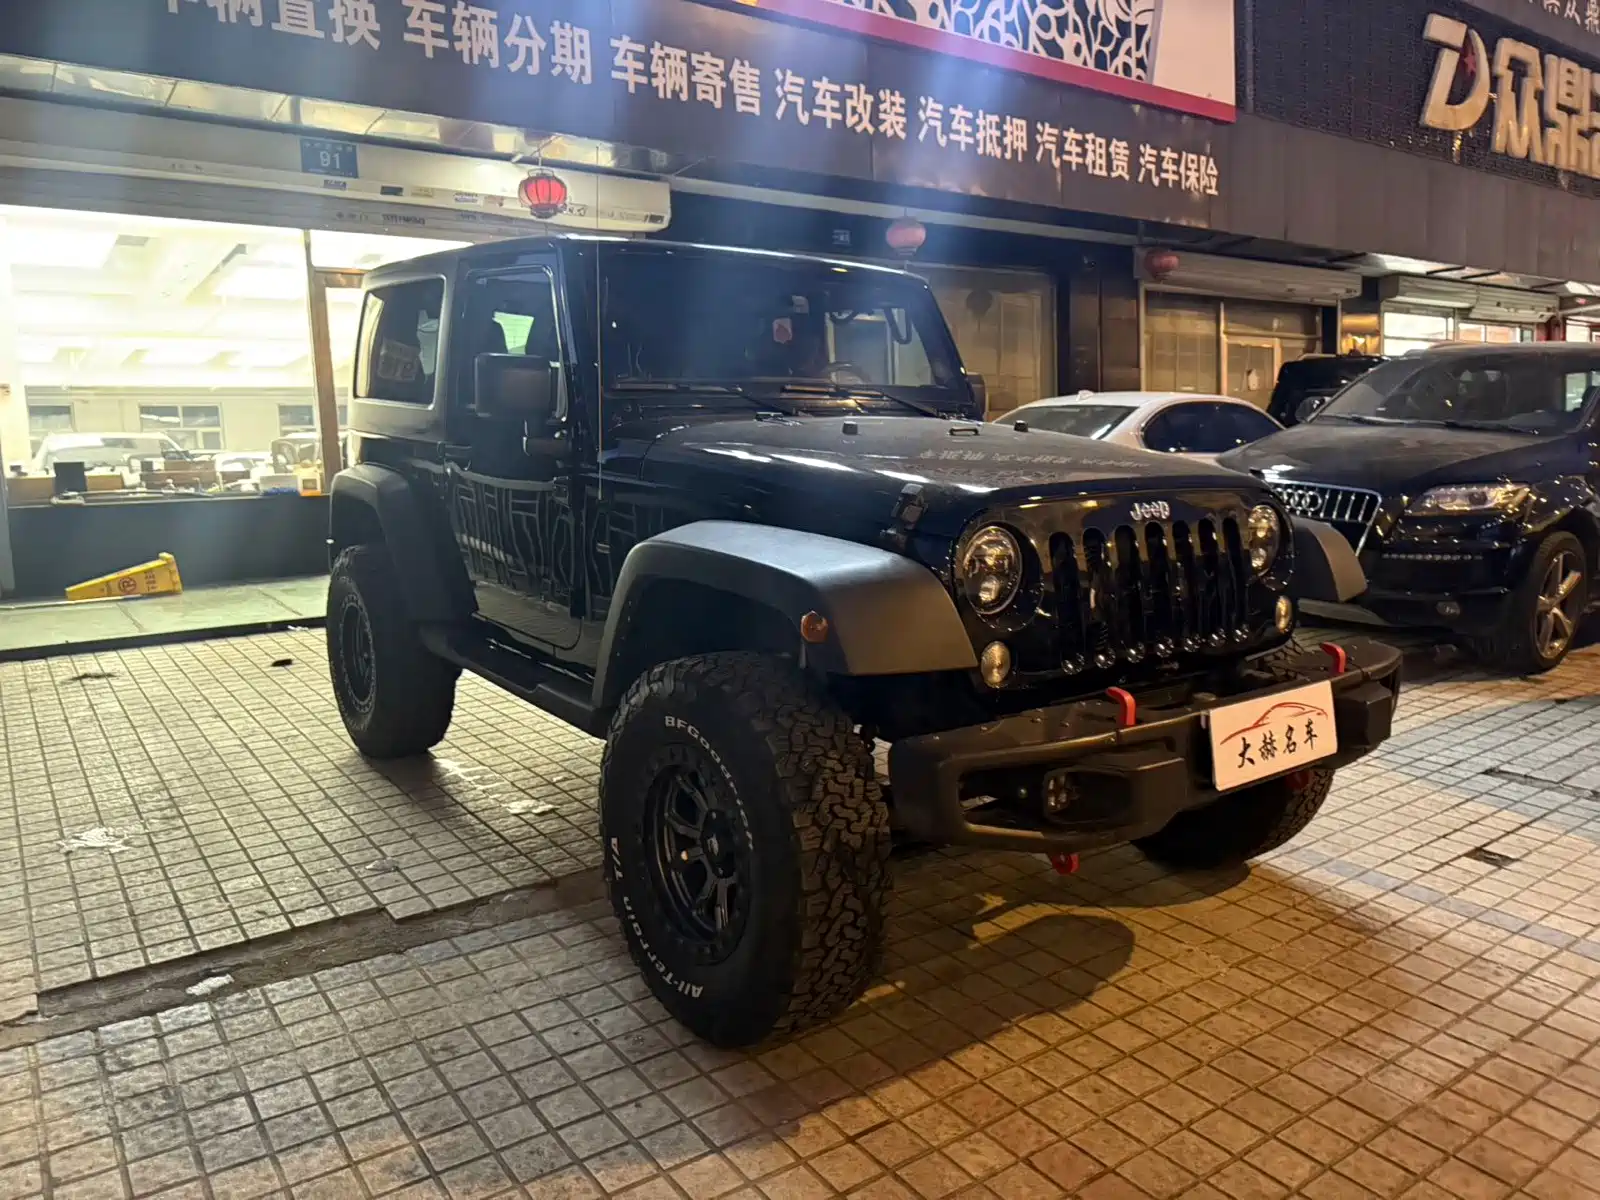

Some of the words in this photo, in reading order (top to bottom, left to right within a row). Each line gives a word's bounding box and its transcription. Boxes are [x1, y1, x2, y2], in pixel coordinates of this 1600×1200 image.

[403, 0, 593, 84] 车辆分期
[610, 35, 762, 116] 车辆寄售
[775, 68, 907, 140] 汽车改装
[918, 96, 1028, 162] 汽车抵押
[1035, 122, 1130, 181] 汽车租赁
[1138, 143, 1219, 196] 汽车保险
[1490, 38, 1600, 179] 众鼎
[1130, 501, 1171, 521] Jeep
